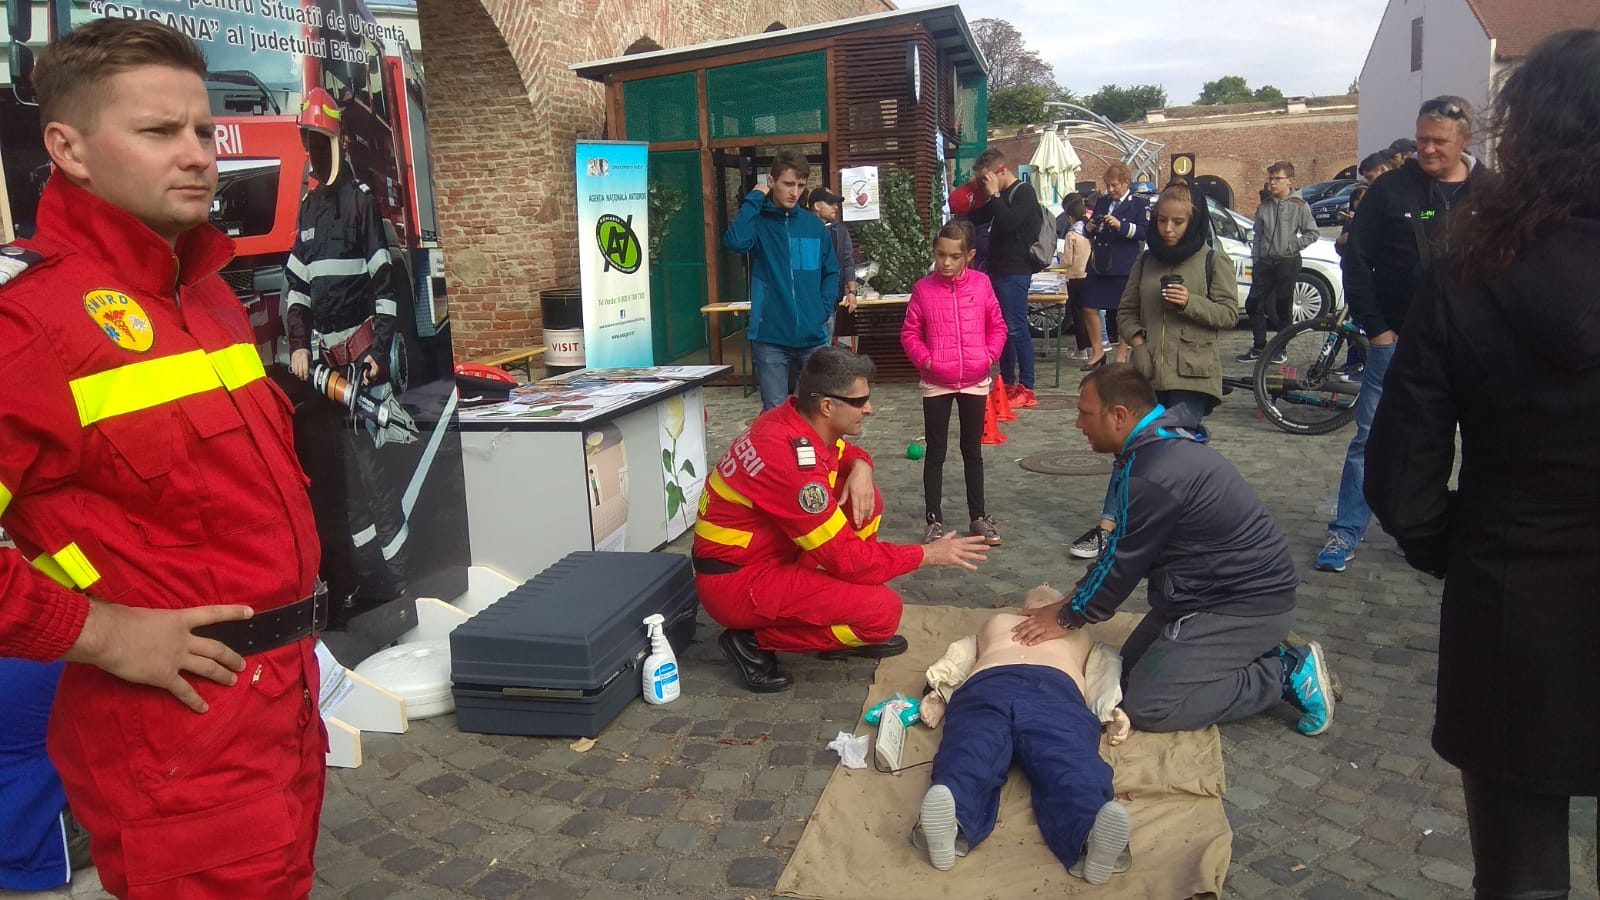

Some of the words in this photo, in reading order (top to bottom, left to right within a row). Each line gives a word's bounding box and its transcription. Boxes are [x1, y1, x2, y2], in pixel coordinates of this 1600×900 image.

[327, 10, 345, 31] de
[227, 25, 245, 45] al
[331, 40, 370, 64] Bihor
[214, 124, 243, 154] RII
[1178, 159, 1187, 174] J
[552, 342, 579, 352] VISIT
